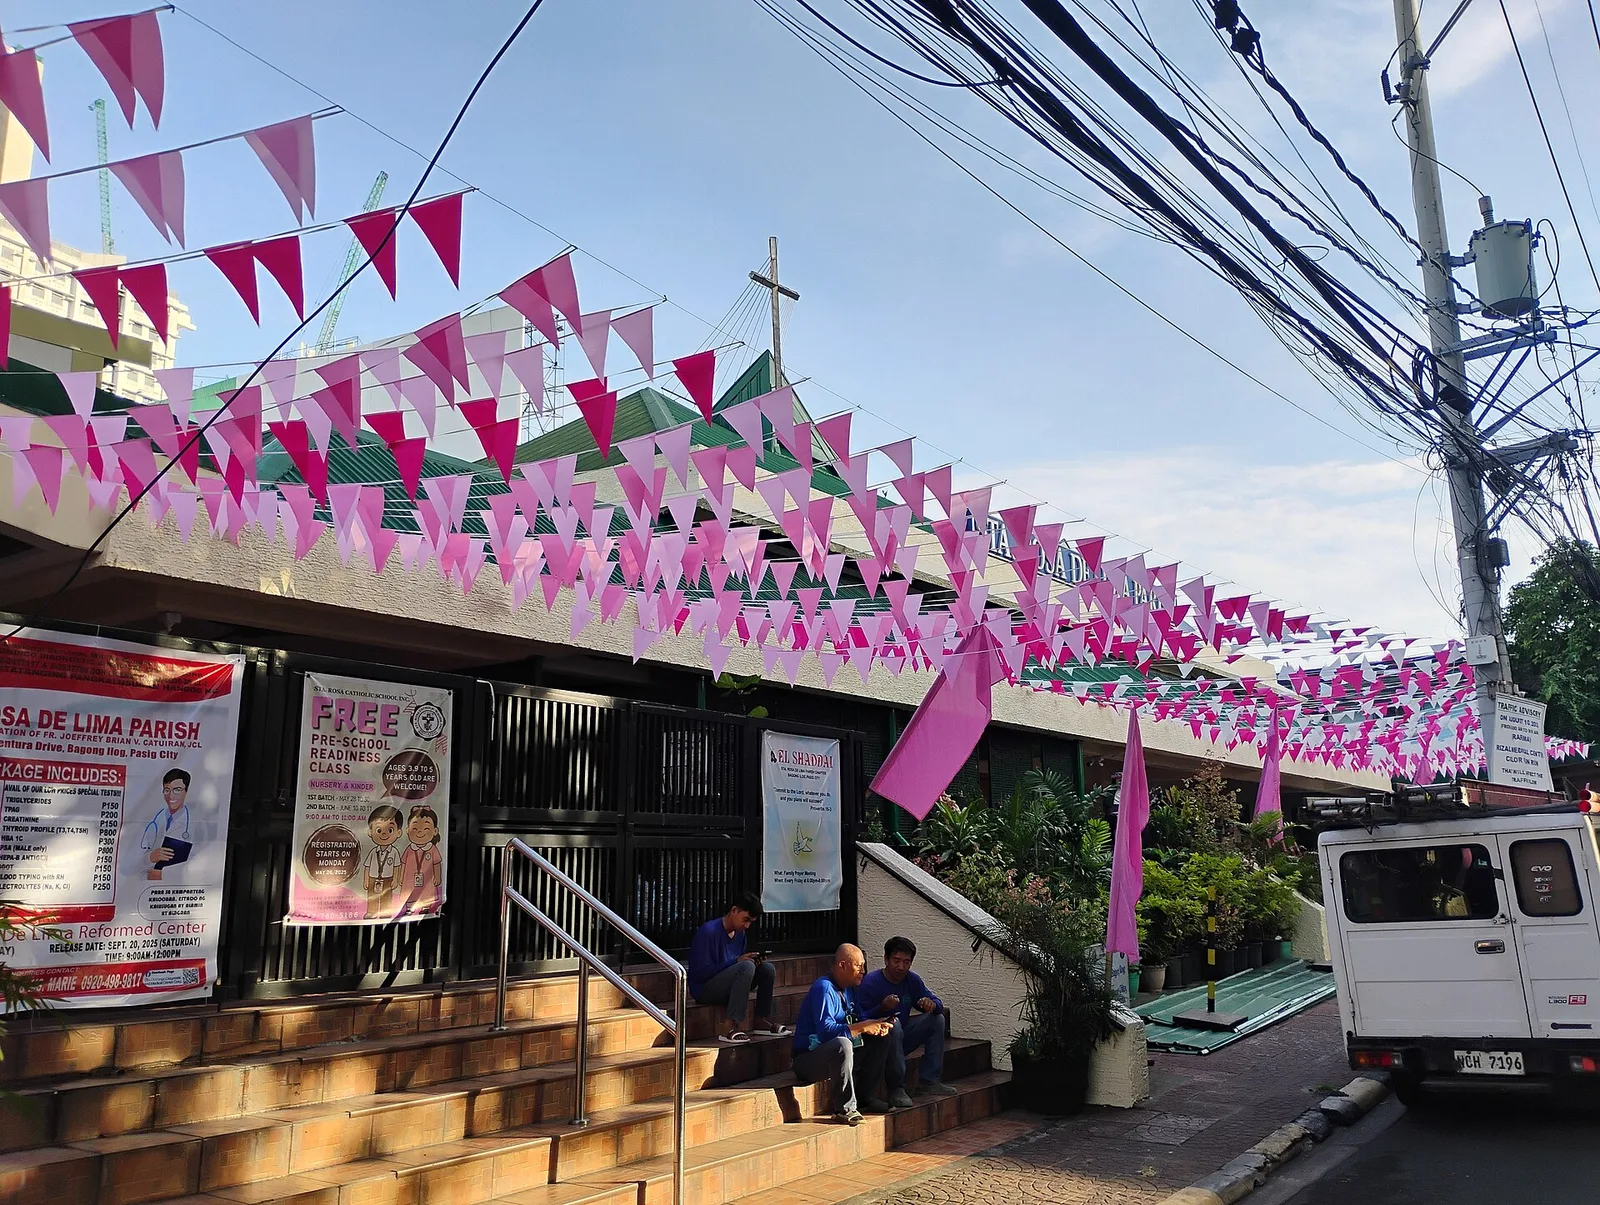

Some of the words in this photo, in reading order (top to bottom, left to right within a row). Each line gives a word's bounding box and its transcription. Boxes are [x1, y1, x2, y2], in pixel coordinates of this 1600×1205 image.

[328, 687, 344, 695] ROSA
[345, 689, 375, 699] CATHOLIC
[375, 692, 398, 701] SCHOOL
[312, 696, 400, 737] FREE
[0, 706, 31, 728] SA
[38, 709, 67, 731] DE
[73, 712, 123, 736] LIMA
[129, 717, 201, 741] PARISH
[29, 730, 41, 738] OF
[43, 731, 57, 739] FR.
[60, 733, 104, 743] JOEFFREY
[106, 736, 132, 745] BRIAN
[188, 741, 203, 749] JCL
[311, 734, 391, 751] PRE-SCHOOL
[67, 743, 105, 757] Bagong
[130, 748, 157, 759] Pasig
[160, 750, 179, 760] City
[311, 748, 381, 763] READINESS
[778, 749, 790, 764] EL
[792, 750, 833, 769] SHADDAI
[0, 762, 44, 779] KAGE
[47, 765, 122, 784] INCLUDES:
[309, 762, 350, 774] CLASS
[388, 764, 407, 772] AGES
[420, 765, 428, 773] TO
[385, 773, 408, 781] YEARS
[4, 784, 21, 793] AVAIL
[23, 785, 30, 793] OF
[77, 787, 100, 797] SPECIAL
[310, 780, 342, 789] NURSERY
[350, 783, 374, 791] KINDER
[393, 783, 427, 791] WELCOME!
[6, 796, 52, 805] TRIGLYCERIDES
[102, 801, 119, 810] P150
[318, 803, 335, 811] BATCH
[101, 811, 118, 819] P200
[2, 824, 30, 833] THYROID
[30, 826, 55, 834] PROFILE
[100, 829, 117, 837] P800
[100, 820, 118, 828] P150
[311, 841, 358, 849] REGISTRATION
[96, 856, 113, 864] P150
[315, 850, 340, 858] STARTS
[94, 864, 112, 873] P150
[318, 859, 347, 867] MONDAY
[93, 873, 112, 882] P150
[92, 882, 111, 891] P250
[79, 922, 153, 939] Reformed
[158, 921, 207, 935] Center
[50, 942, 83, 953] RELEASE
[85, 941, 106, 952] DATE:
[108, 940, 128, 950] SEPT.
[129, 940, 140, 950] 20,
[142, 939, 158, 948] 2025
[160, 937, 201, 949] (SATURDAY)
[105, 952, 125, 962] TIME:
[127, 949, 182, 961] 9:00AM-12:00PM
[47, 975, 77, 992] MARIE
[81, 972, 142, 990] 0920-498-9817
[1489, 1055, 1522, 1071] 7196
